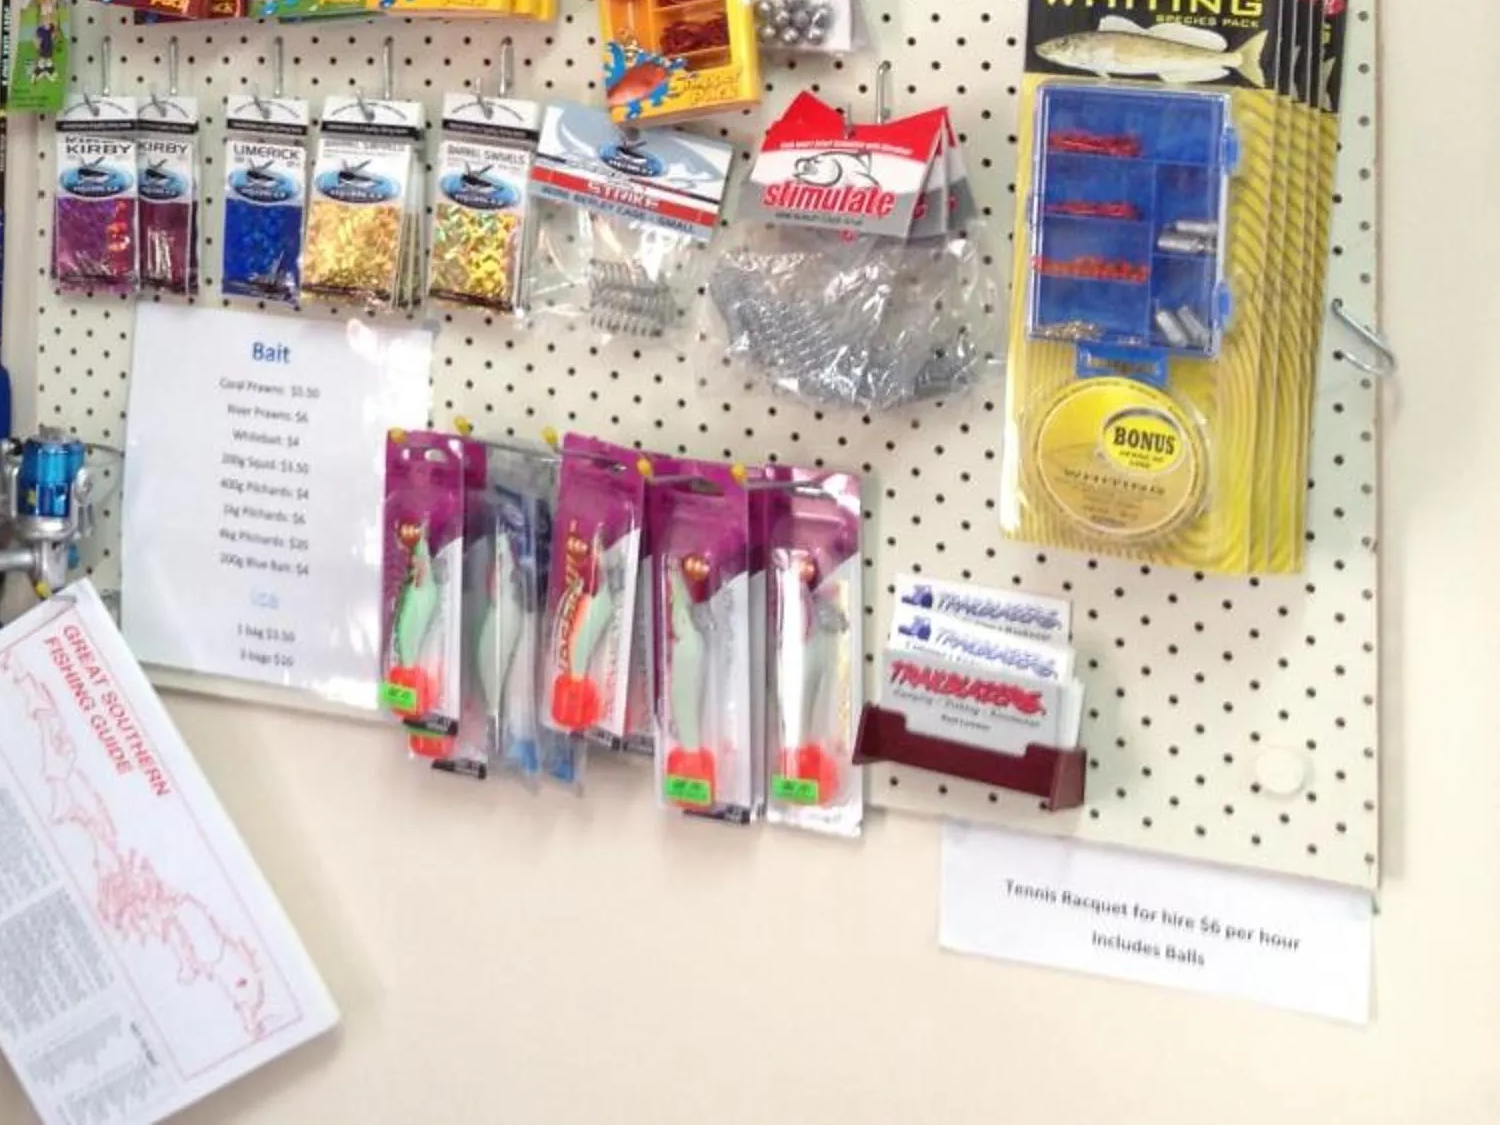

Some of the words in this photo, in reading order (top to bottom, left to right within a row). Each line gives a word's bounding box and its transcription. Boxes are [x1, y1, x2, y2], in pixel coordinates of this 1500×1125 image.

[1155, 13, 1218, 26] SPECIES
[1222, 18, 1260, 28] PACK
[67, 143, 131, 155] KIRBY
[138, 141, 188, 155] KIRBY
[233, 143, 300, 161] LIMERICK
[764, 181, 896, 219] stimulate
[252, 341, 291, 364] Bait
[1113, 425, 1176, 456] BONUS
[246, 624, 264, 640] bag
[44, 636, 96, 712] FISHING
[91, 714, 133, 775] GUIDE
[63, 625, 108, 686] GREAT
[101, 690, 171, 797] SOUTHERN
[1005, 879, 1057, 904] Tennis
[1062, 890, 1127, 919] Racquet
[1133, 903, 1157, 923] for
[1161, 909, 1195, 931] hire
[1200, 917, 1221, 936] $6
[1225, 926, 1255, 945] per
[1259, 928, 1301, 951] hour
[1092, 930, 1160, 959] Includes
[1165, 945, 1205, 967] Balls
